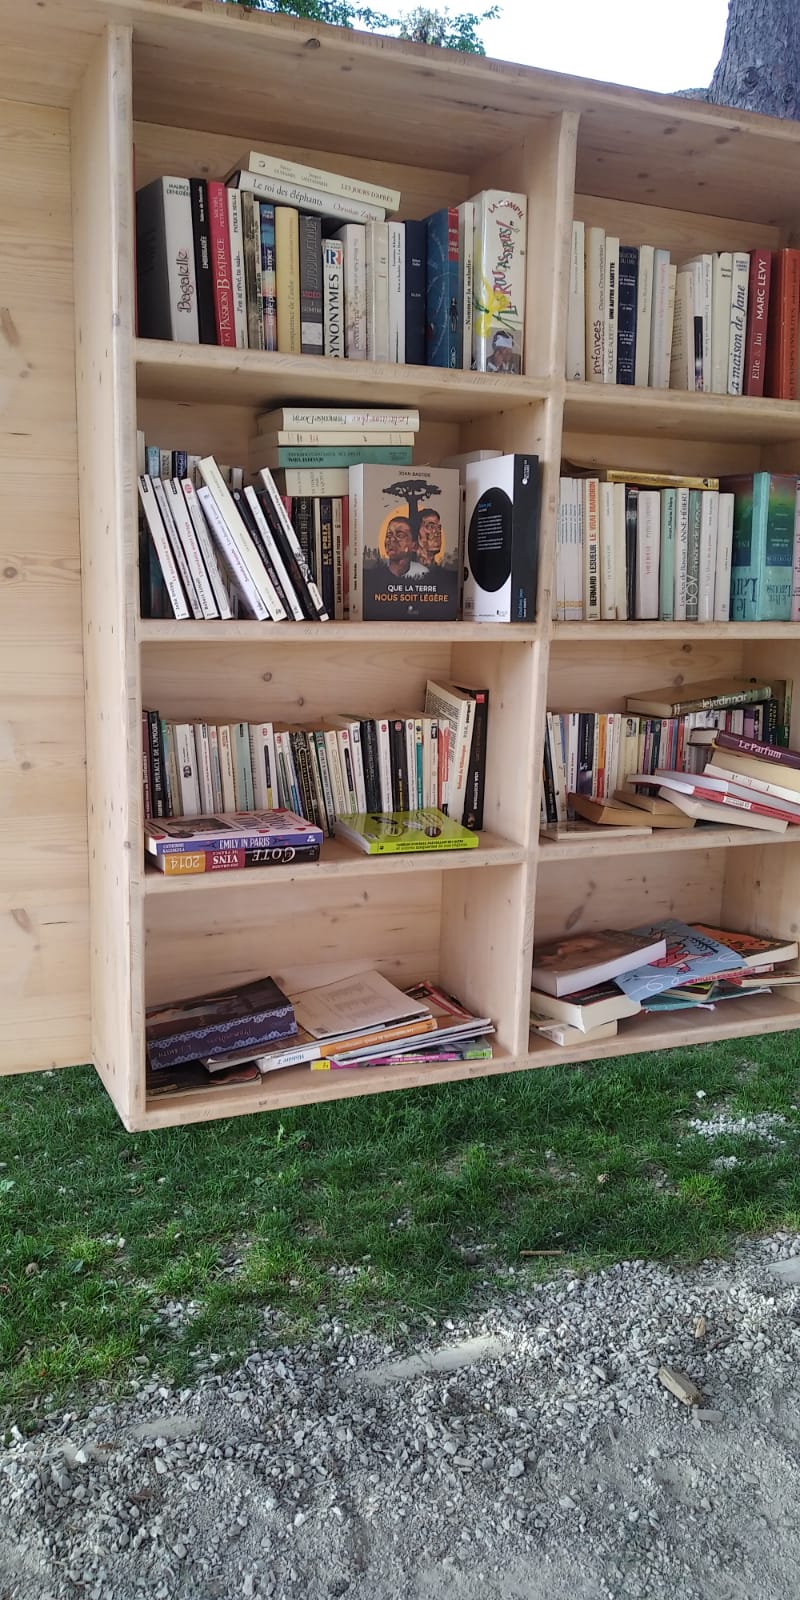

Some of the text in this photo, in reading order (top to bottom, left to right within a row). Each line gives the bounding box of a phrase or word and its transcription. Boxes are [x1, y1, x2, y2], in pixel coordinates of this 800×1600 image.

[253, 179, 263, 190] Le
[264, 182, 275, 193] roi
[276, 184, 289, 198] des
[289, 190, 323, 207] éléphants
[175, 248, 194, 314] Bagatelle
[757, 258, 767, 286] LEVY
[731, 284, 746, 317] Jane
[755, 288, 766, 320] MARC
[219, 291, 231, 331] PASSION
[730, 316, 744, 331] de
[224, 333, 231, 342] LA
[753, 332, 763, 346] lui
[730, 334, 742, 379] maison
[751, 360, 760, 380] Elle
[590, 533, 597, 541] LE
[323, 554, 329, 565] LE
[589, 544, 597, 574] LESUEUR
[374, 593, 449, 602] NOUS SOIT LÉGÈRE
[387, 584, 403, 593] QUE
[415, 585, 437, 593] TERRE
[589, 576, 597, 607] BERNARD
[153, 748, 159, 756] DE
[738, 740, 782, 759] Le Parfum
[219, 836, 271, 850] EMILY IN PARIS
[170, 847, 296, 868] COTE 2014
[212, 854, 239, 864] VINS
